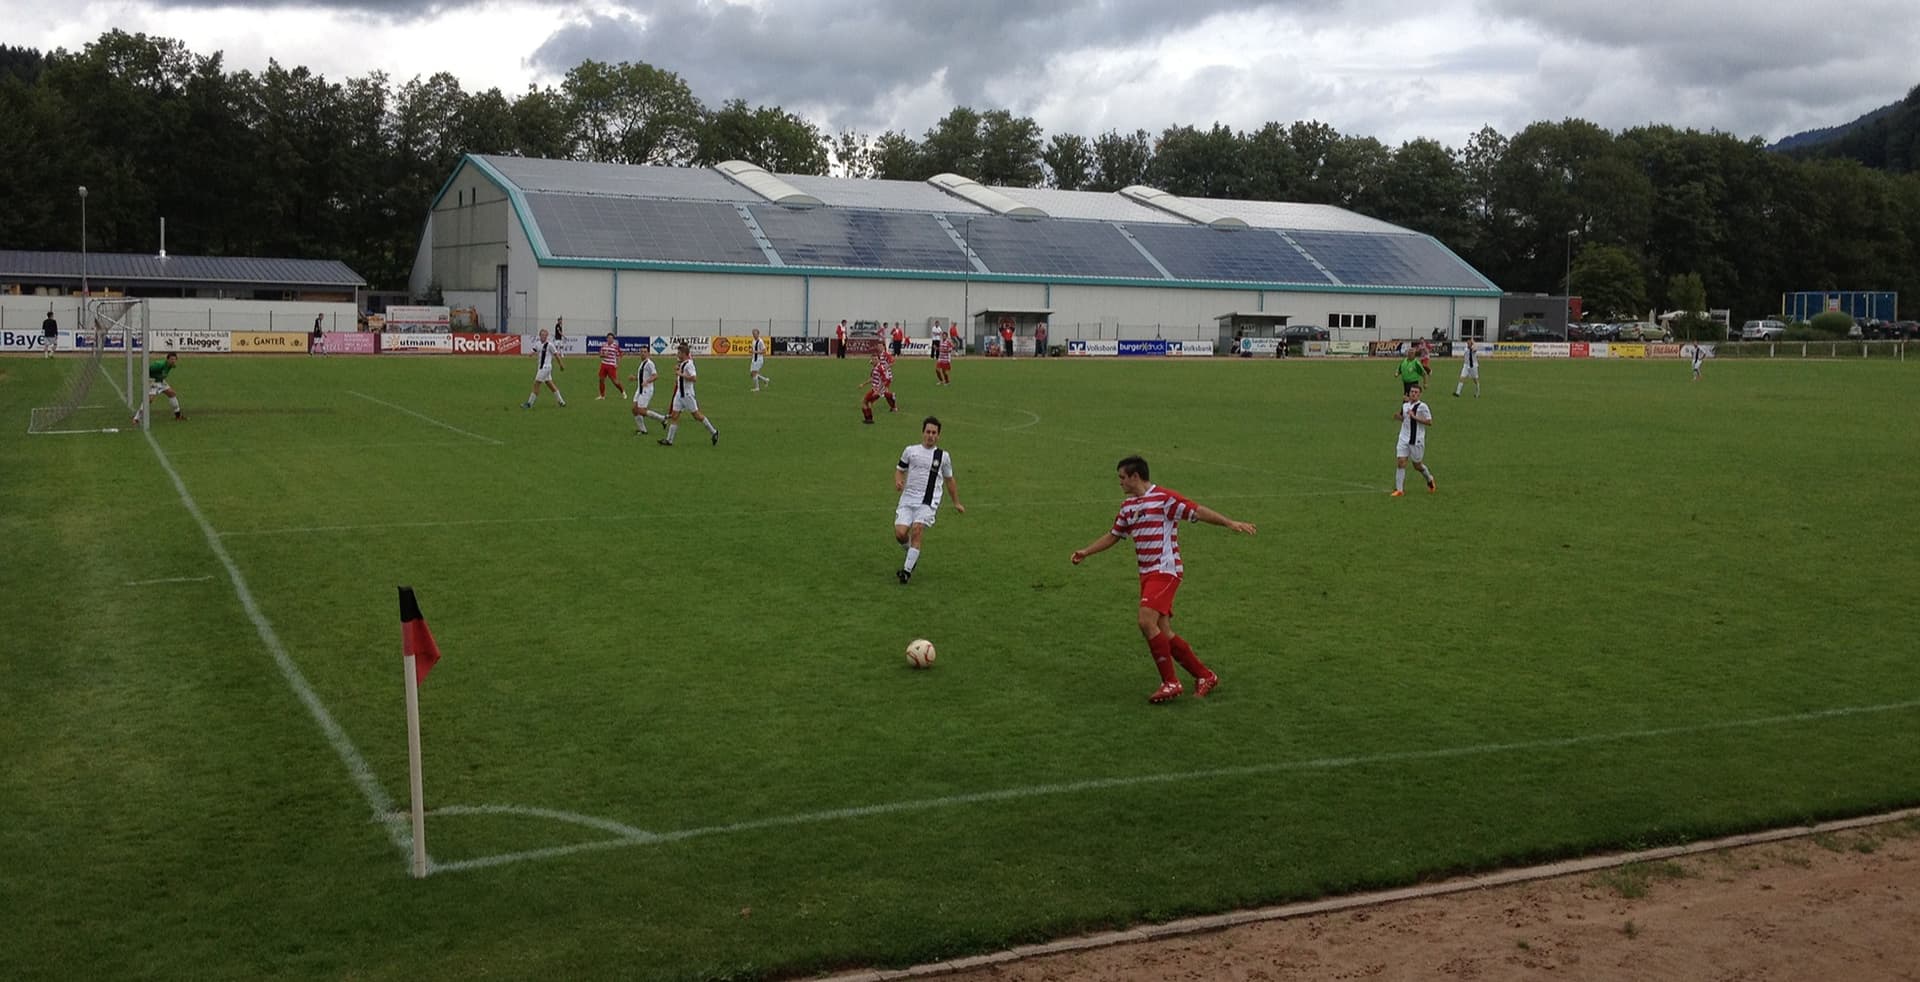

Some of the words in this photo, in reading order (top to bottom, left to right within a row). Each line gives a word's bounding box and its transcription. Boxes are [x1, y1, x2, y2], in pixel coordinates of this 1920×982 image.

[3, 331, 46, 349] Baye
[253, 337, 286, 346] GANTER
[454, 333, 496, 352] Reich
